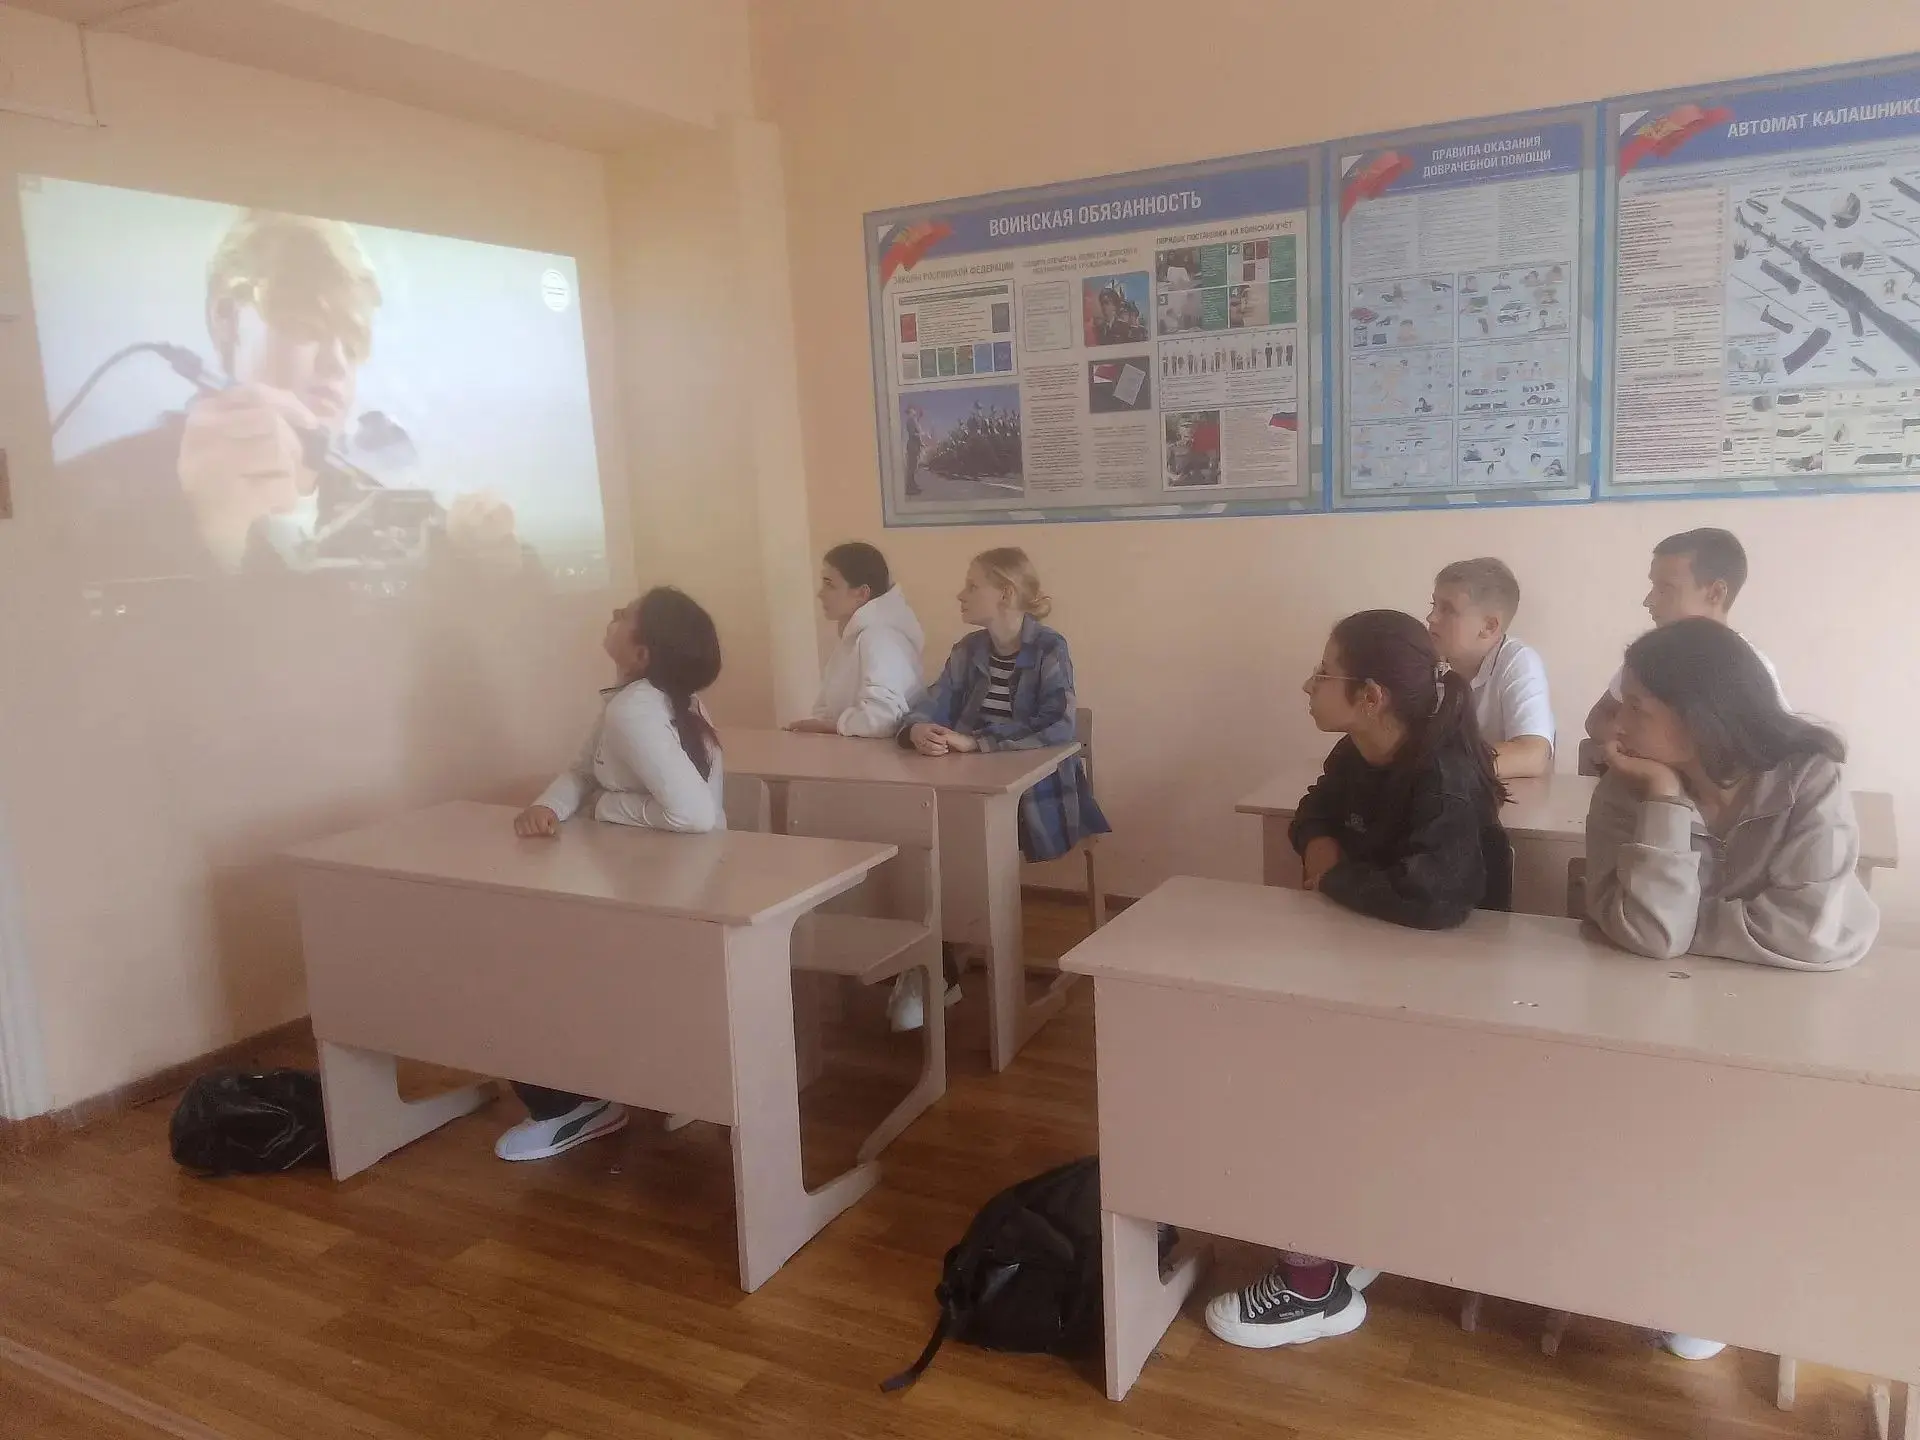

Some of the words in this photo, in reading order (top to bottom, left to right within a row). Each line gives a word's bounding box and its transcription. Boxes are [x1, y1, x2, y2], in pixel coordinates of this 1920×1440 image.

[1727, 113, 1808, 138] АВТОМАТ
[1432, 143, 1481, 161] ПРАВИЛА
[1483, 134, 1542, 154] ОКАЗАНИЯ
[1423, 157, 1498, 179] ДОВРАЧЕБНОЙ
[1501, 149, 1551, 168] ПОМОЩИ
[989, 208, 1074, 237] ВОИНСКАЯ
[1078, 190, 1202, 225] ОБЯЗАННОСТЬ
